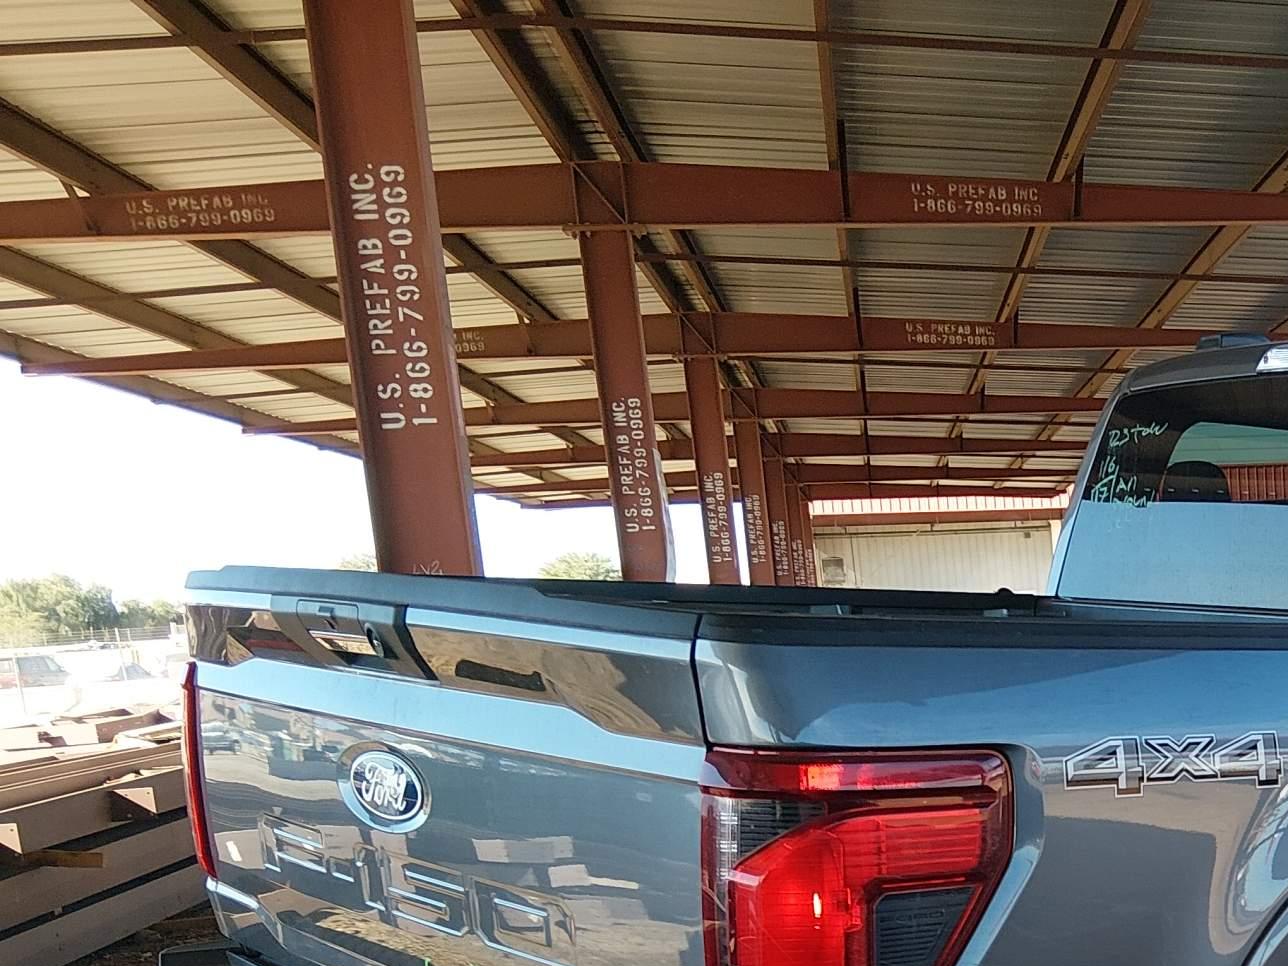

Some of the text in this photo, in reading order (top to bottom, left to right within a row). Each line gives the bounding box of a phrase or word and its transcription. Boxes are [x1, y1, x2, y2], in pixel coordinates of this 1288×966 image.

[126, 199, 159, 214] U.S.
[167, 195, 233, 211] PREFAB
[913, 199, 1042, 216] 1-866-799-0969
[948, 183, 1007, 200] PREFAB
[348, 163, 406, 430] U.S. PREFAB INC.
[379, 165, 438, 426] 1-866-799-0969
[931, 323, 971, 335] PREFAB
[612, 397, 640, 532] U.S. PREFAB INC.
[628, 398, 656, 530] 1-866-799-0969
[705, 497, 719, 537] PREFAB
[361, 758, 409, 813] Ford
